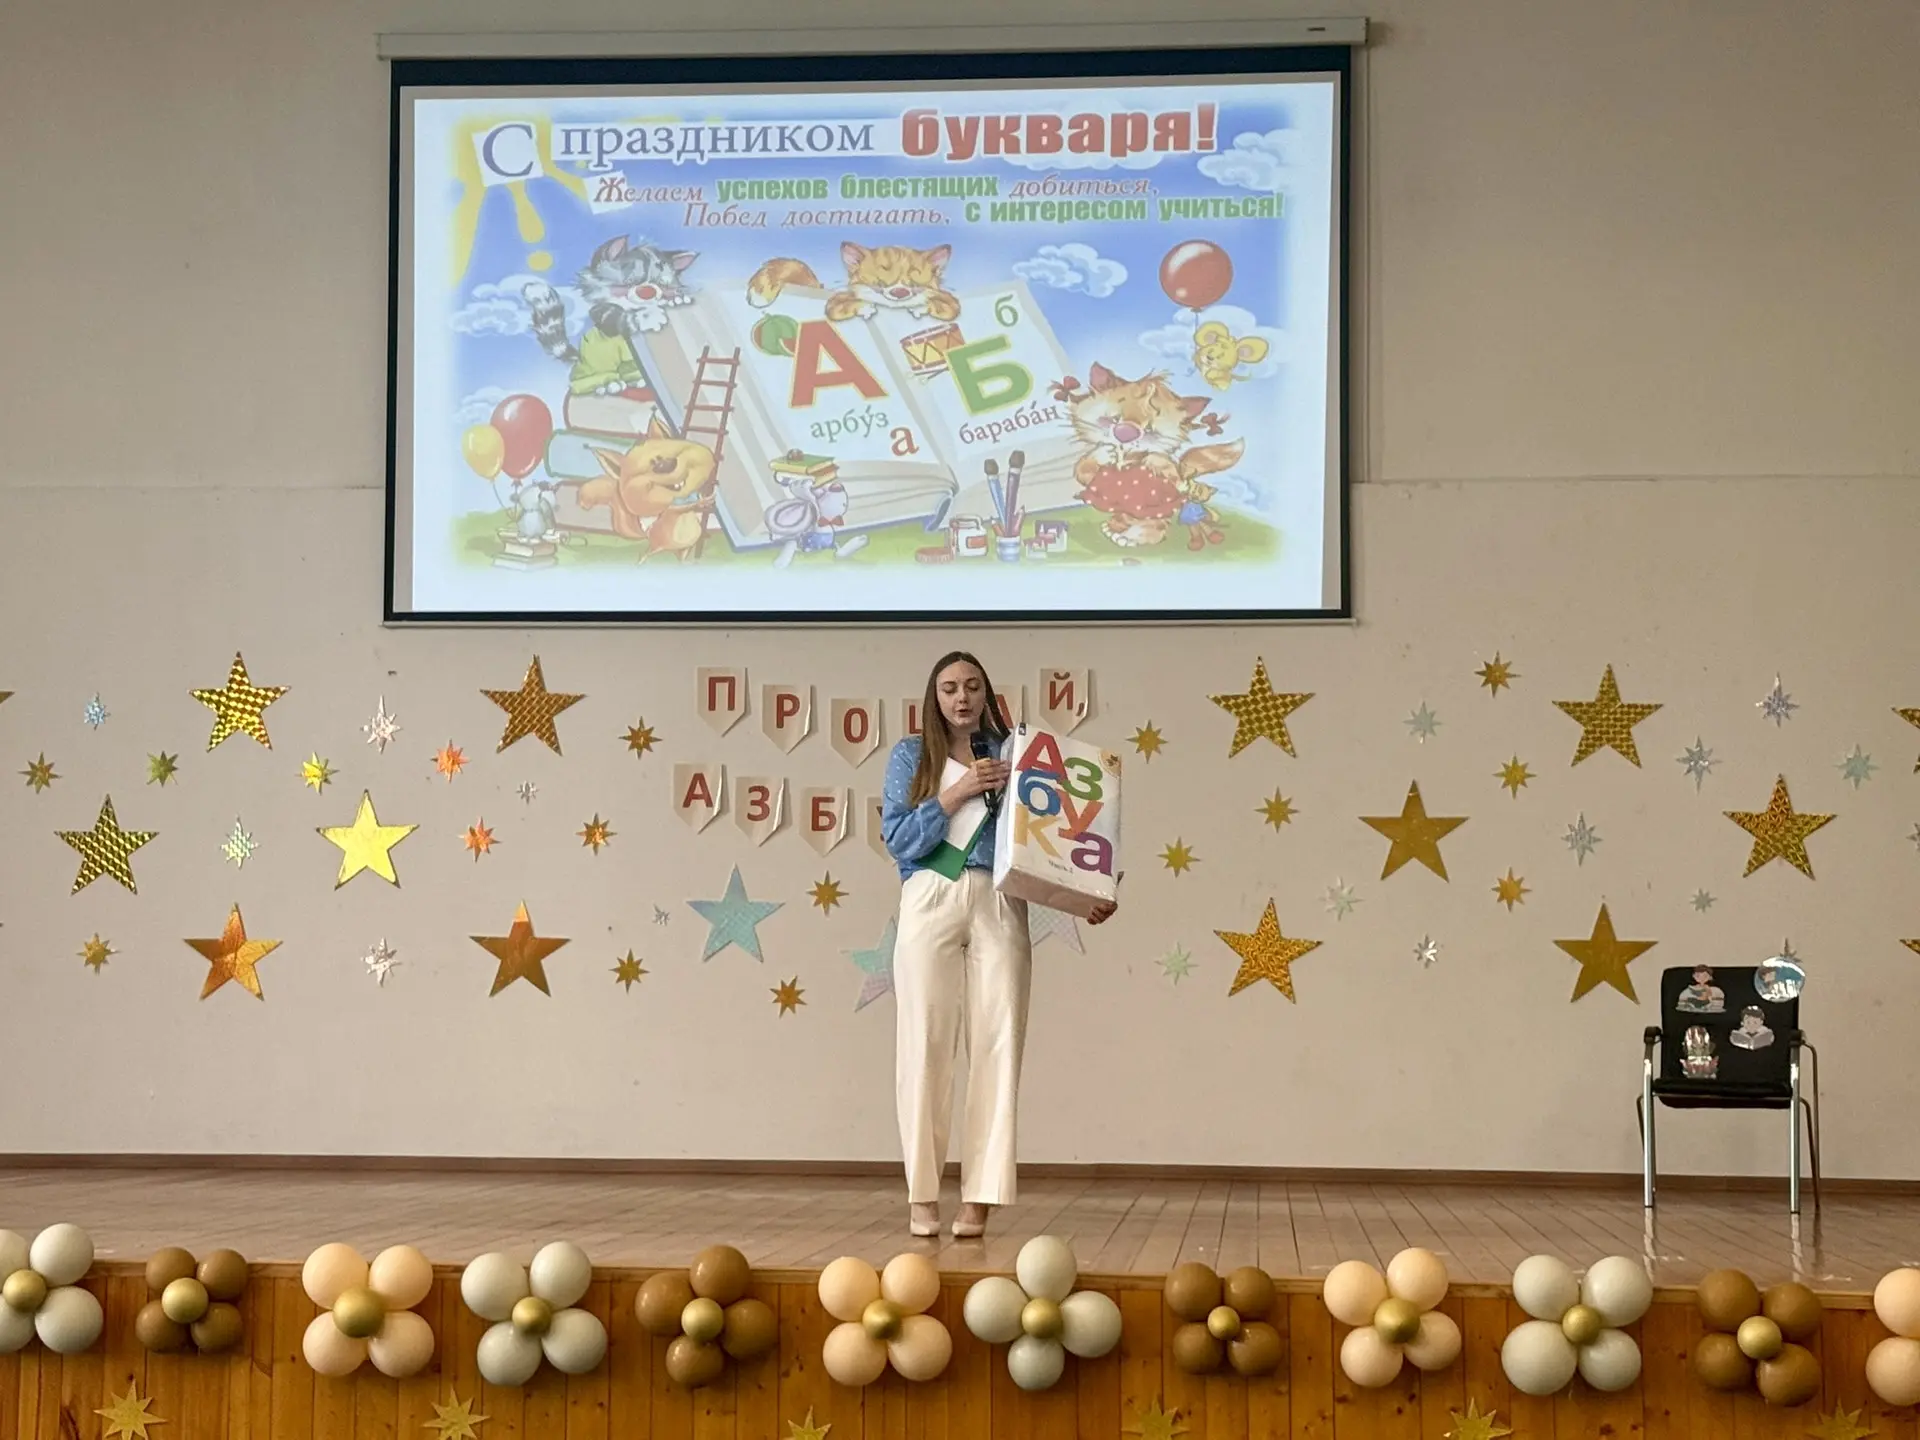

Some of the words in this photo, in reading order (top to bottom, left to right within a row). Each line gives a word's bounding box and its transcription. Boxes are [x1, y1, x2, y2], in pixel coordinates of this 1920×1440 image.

[482, 124, 534, 177] С
[560, 124, 874, 167] праздником
[901, 103, 1216, 159] букваря!
[594, 177, 703, 202] Желаем
[717, 178, 829, 202] успехов
[841, 174, 999, 200] блестящих
[1009, 175, 1159, 198] добиться,
[683, 203, 767, 227] Побед
[781, 207, 950, 227] достигать,
[965, 202, 980, 222] с
[990, 199, 1146, 223] интересом
[1158, 193, 1284, 221] учиться!
[994, 294, 1019, 327] б
[789, 320, 888, 408] А
[946, 334, 1033, 417] Б
[890, 425, 919, 457] а
[682, 772, 885, 842] АЗБ
